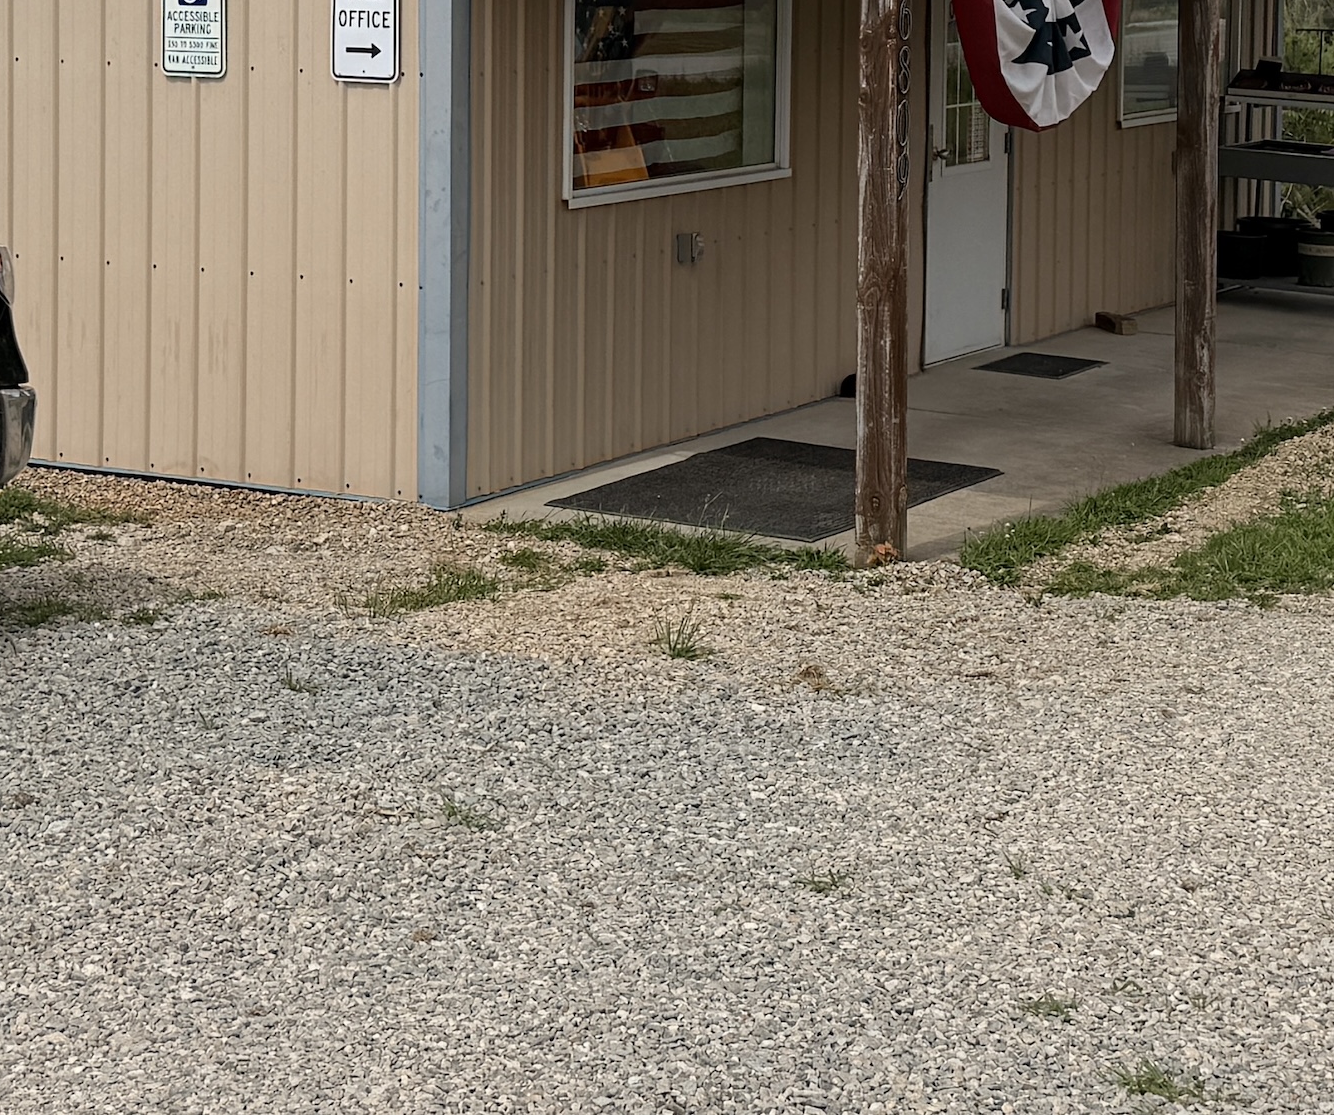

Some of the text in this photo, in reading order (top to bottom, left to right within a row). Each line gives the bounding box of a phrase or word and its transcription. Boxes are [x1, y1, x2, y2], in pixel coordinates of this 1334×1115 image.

[167, 11, 218, 22] ACCESSIBLE
[338, 9, 391, 29] OFFICE
[174, 23, 211, 34] PARKING
[182, 55, 218, 65] ACCESSIBLE
